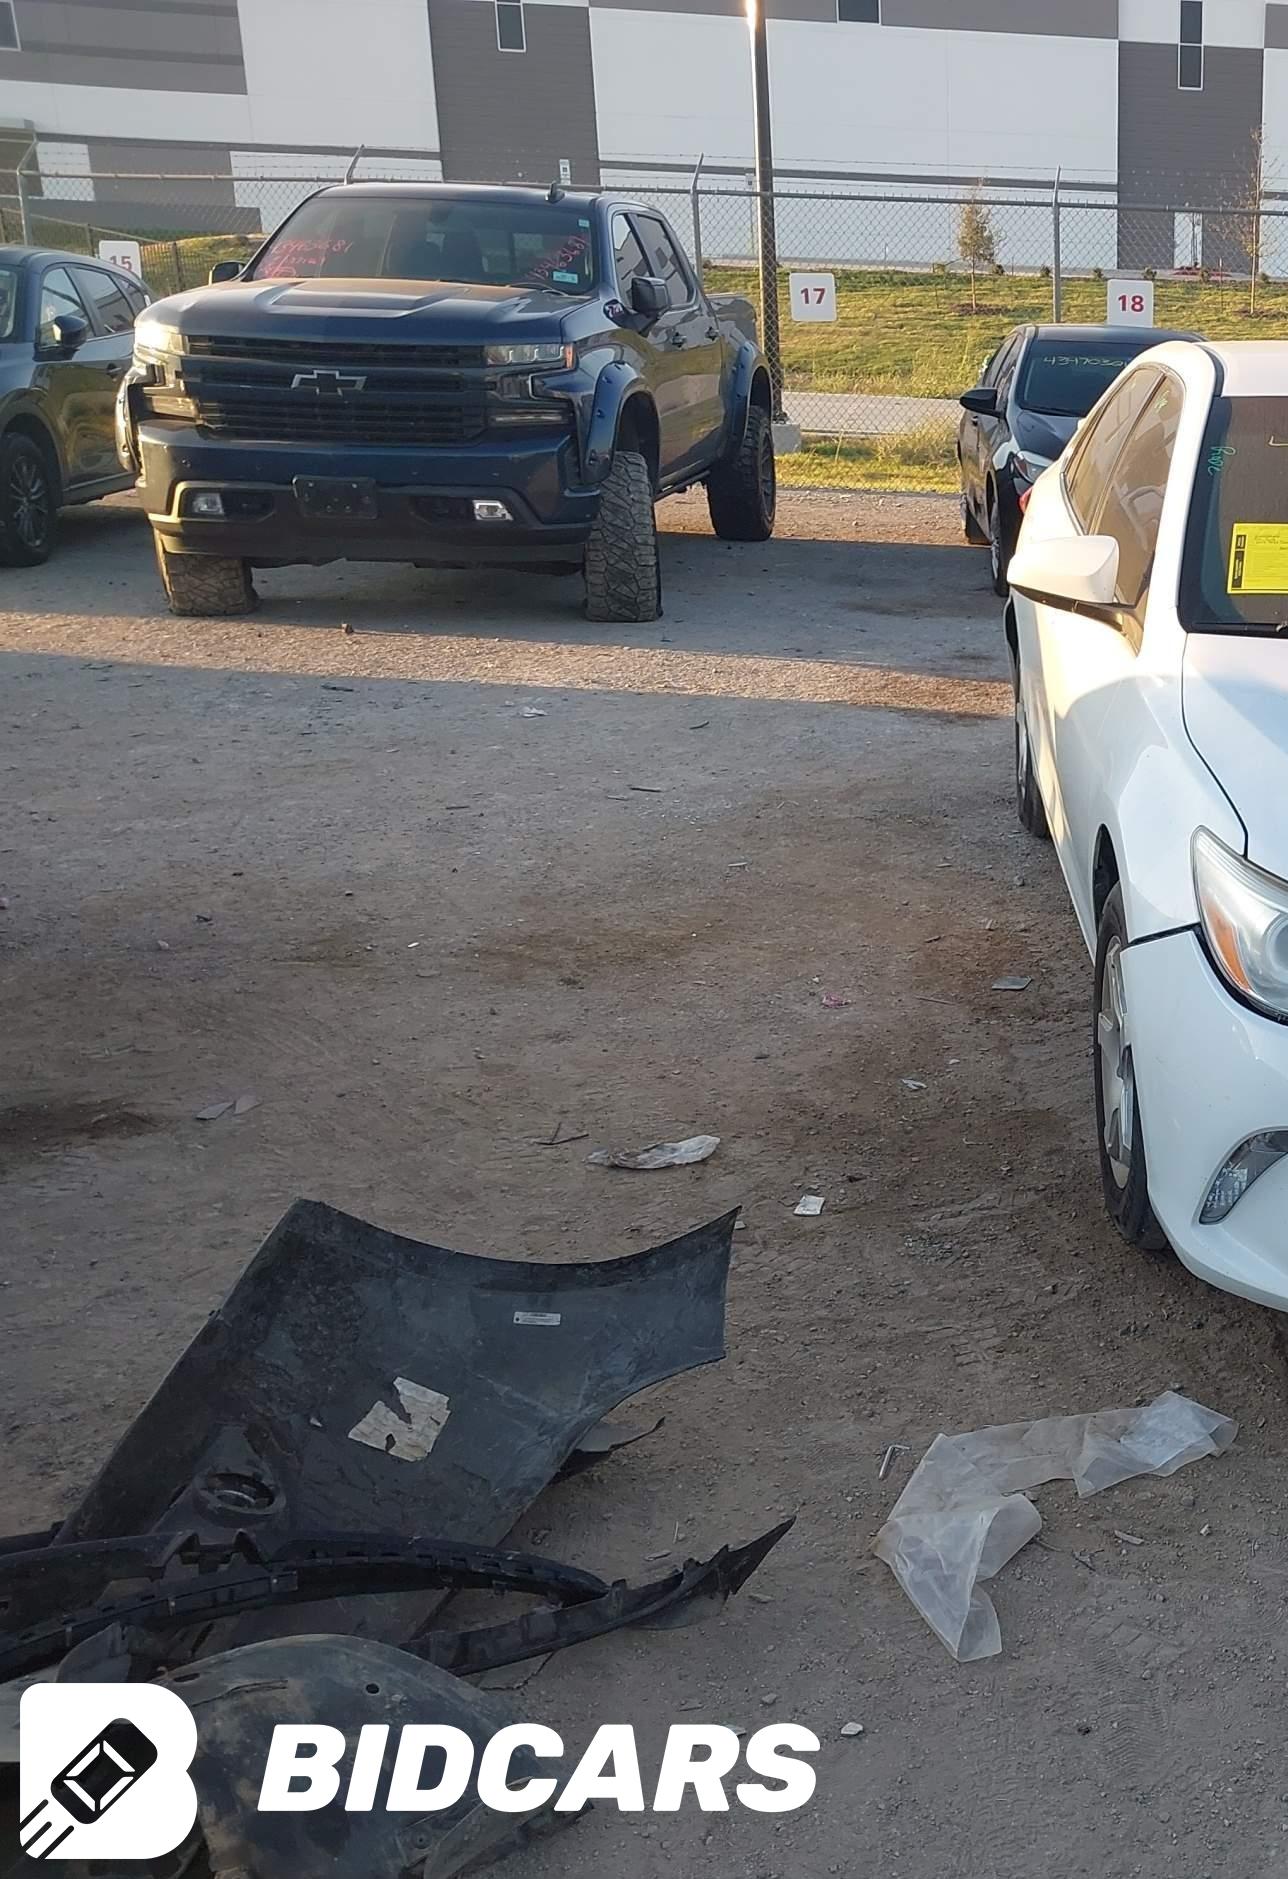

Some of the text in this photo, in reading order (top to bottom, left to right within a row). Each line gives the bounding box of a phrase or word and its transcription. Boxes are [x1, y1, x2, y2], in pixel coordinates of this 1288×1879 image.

[109, 255, 133, 272] 15
[800, 287, 826, 305] 17
[1118, 294, 1144, 313] 18
